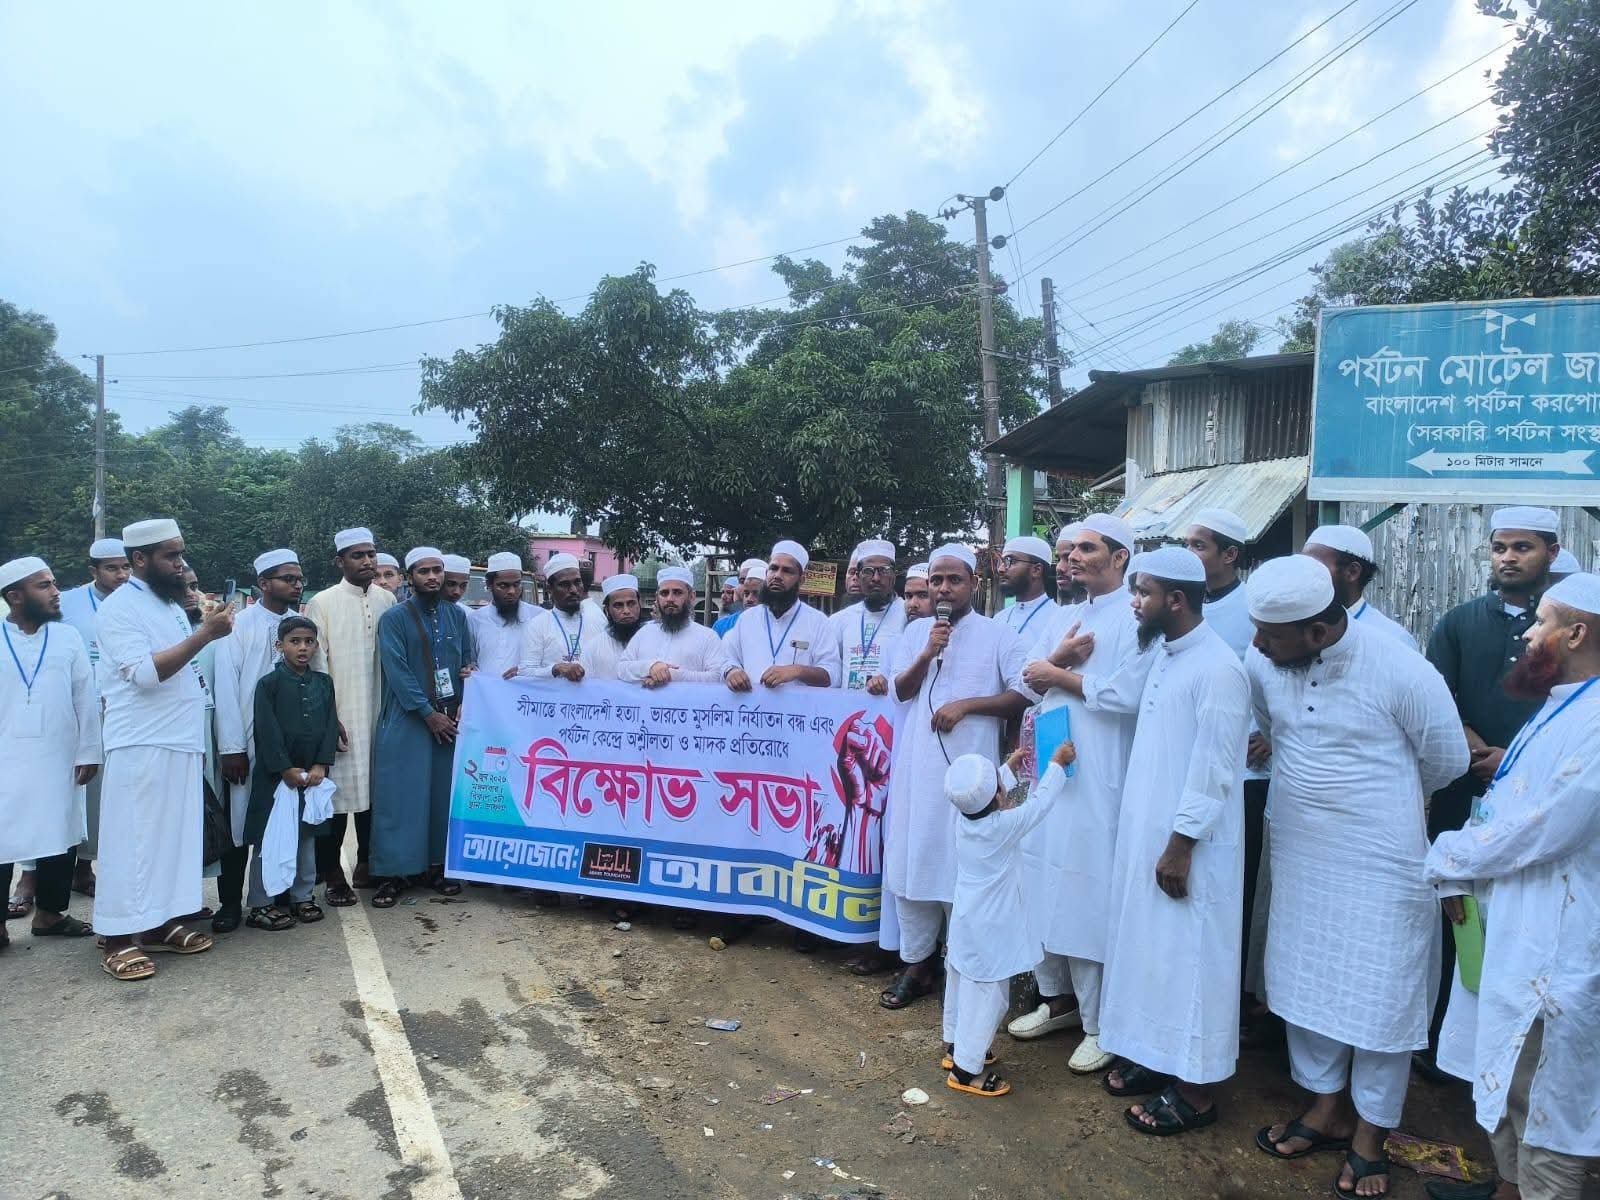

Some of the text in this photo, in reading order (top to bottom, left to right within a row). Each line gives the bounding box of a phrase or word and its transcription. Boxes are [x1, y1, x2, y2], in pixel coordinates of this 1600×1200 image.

[1338, 345, 1430, 387] পর্যটন
[1439, 343, 1554, 386] মোটেল
[1364, 390, 1600, 416] বাংলাদেশ পর্যটন করপো
[1406, 420, 1488, 446] (সরকারি
[1495, 418, 1555, 442] পর্যটন
[1447, 454, 1543, 467] ১০০ মিটার সামনে
[516, 694, 557, 718] সীমান্তে
[560, 699, 613, 721] বাংলাদেশী
[650, 706, 689, 725] ভারতে
[692, 703, 733, 730] মুসলিম
[738, 704, 784, 729] নির্যাতন
[787, 713, 807, 733] বন্ধ
[810, 715, 835, 737] এবং
[559, 723, 790, 758] পর্যটন কেন্দ্রে অশ্লীলতা ও মাদক প্রতিরোধে
[519, 736, 823, 843] বিক্ষোভ সভা
[462, 833, 580, 872] আয়োজনে:
